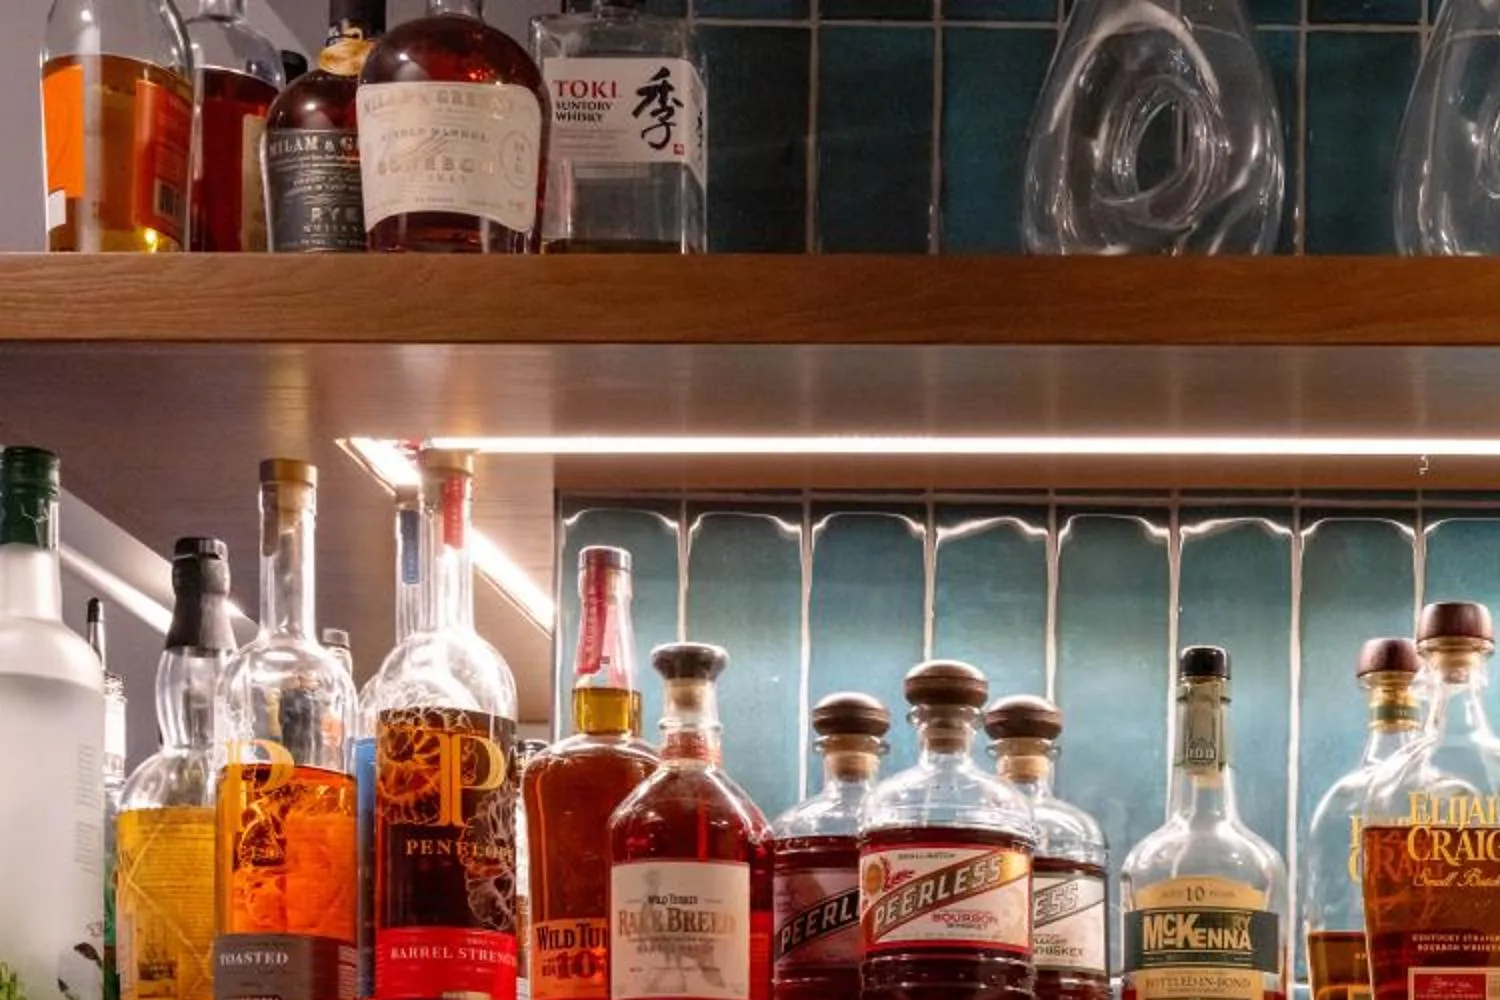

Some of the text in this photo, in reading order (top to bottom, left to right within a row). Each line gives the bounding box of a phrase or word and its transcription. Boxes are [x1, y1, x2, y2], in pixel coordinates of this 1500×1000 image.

[553, 79, 617, 98] TOKI
[556, 101, 612, 110] SUNTORY
[631, 66, 684, 150] 季
[556, 111, 603, 122] WHISKY
[873, 855, 1003, 930] PEERLESS
[1186, 886, 1205, 902] 10
[537, 924, 576, 950] WILD
[220, 951, 290, 969] TOASTED
[390, 945, 454, 962] BARREL
